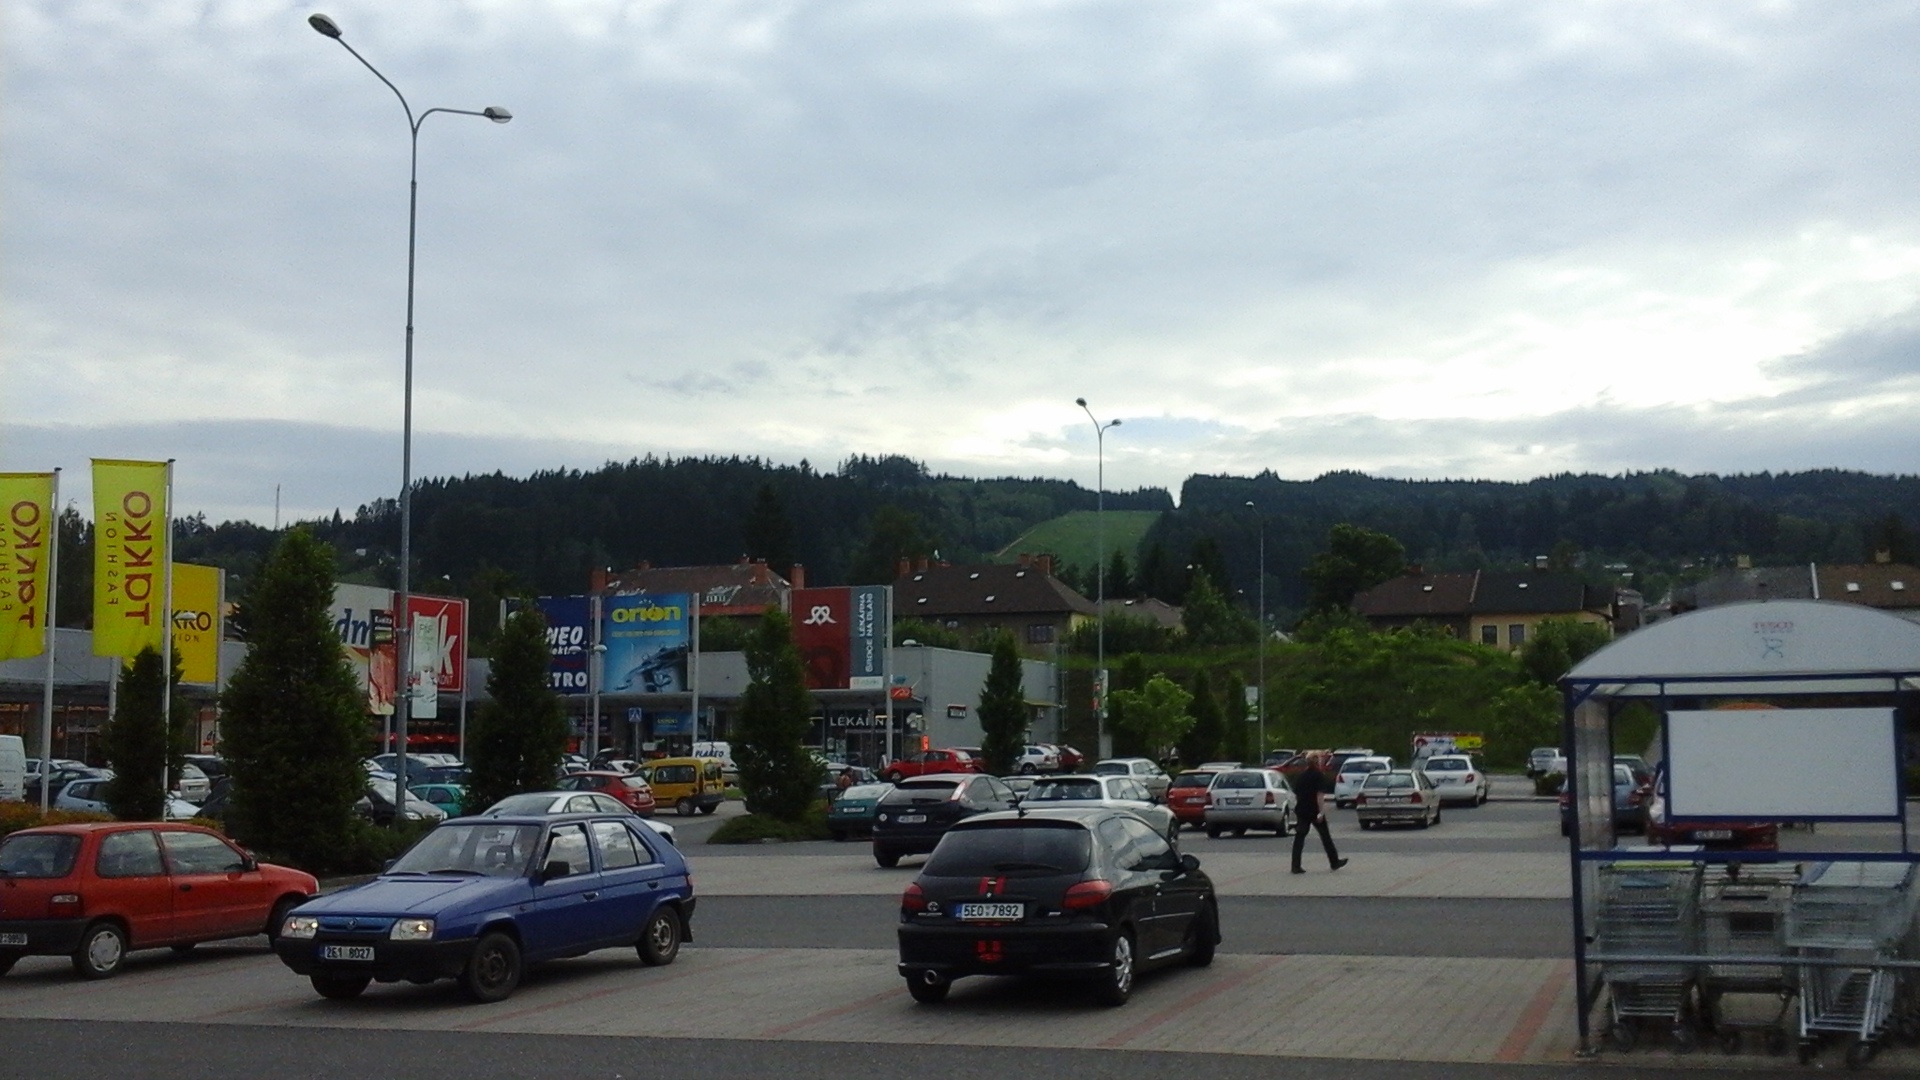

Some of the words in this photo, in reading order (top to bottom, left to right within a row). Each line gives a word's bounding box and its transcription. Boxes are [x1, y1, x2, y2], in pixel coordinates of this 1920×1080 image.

[611, 604, 682, 623] orion
[544, 625, 584, 646] NEO
[991, 904, 1019, 917] 7892
[348, 947, 371, 959] 8027
